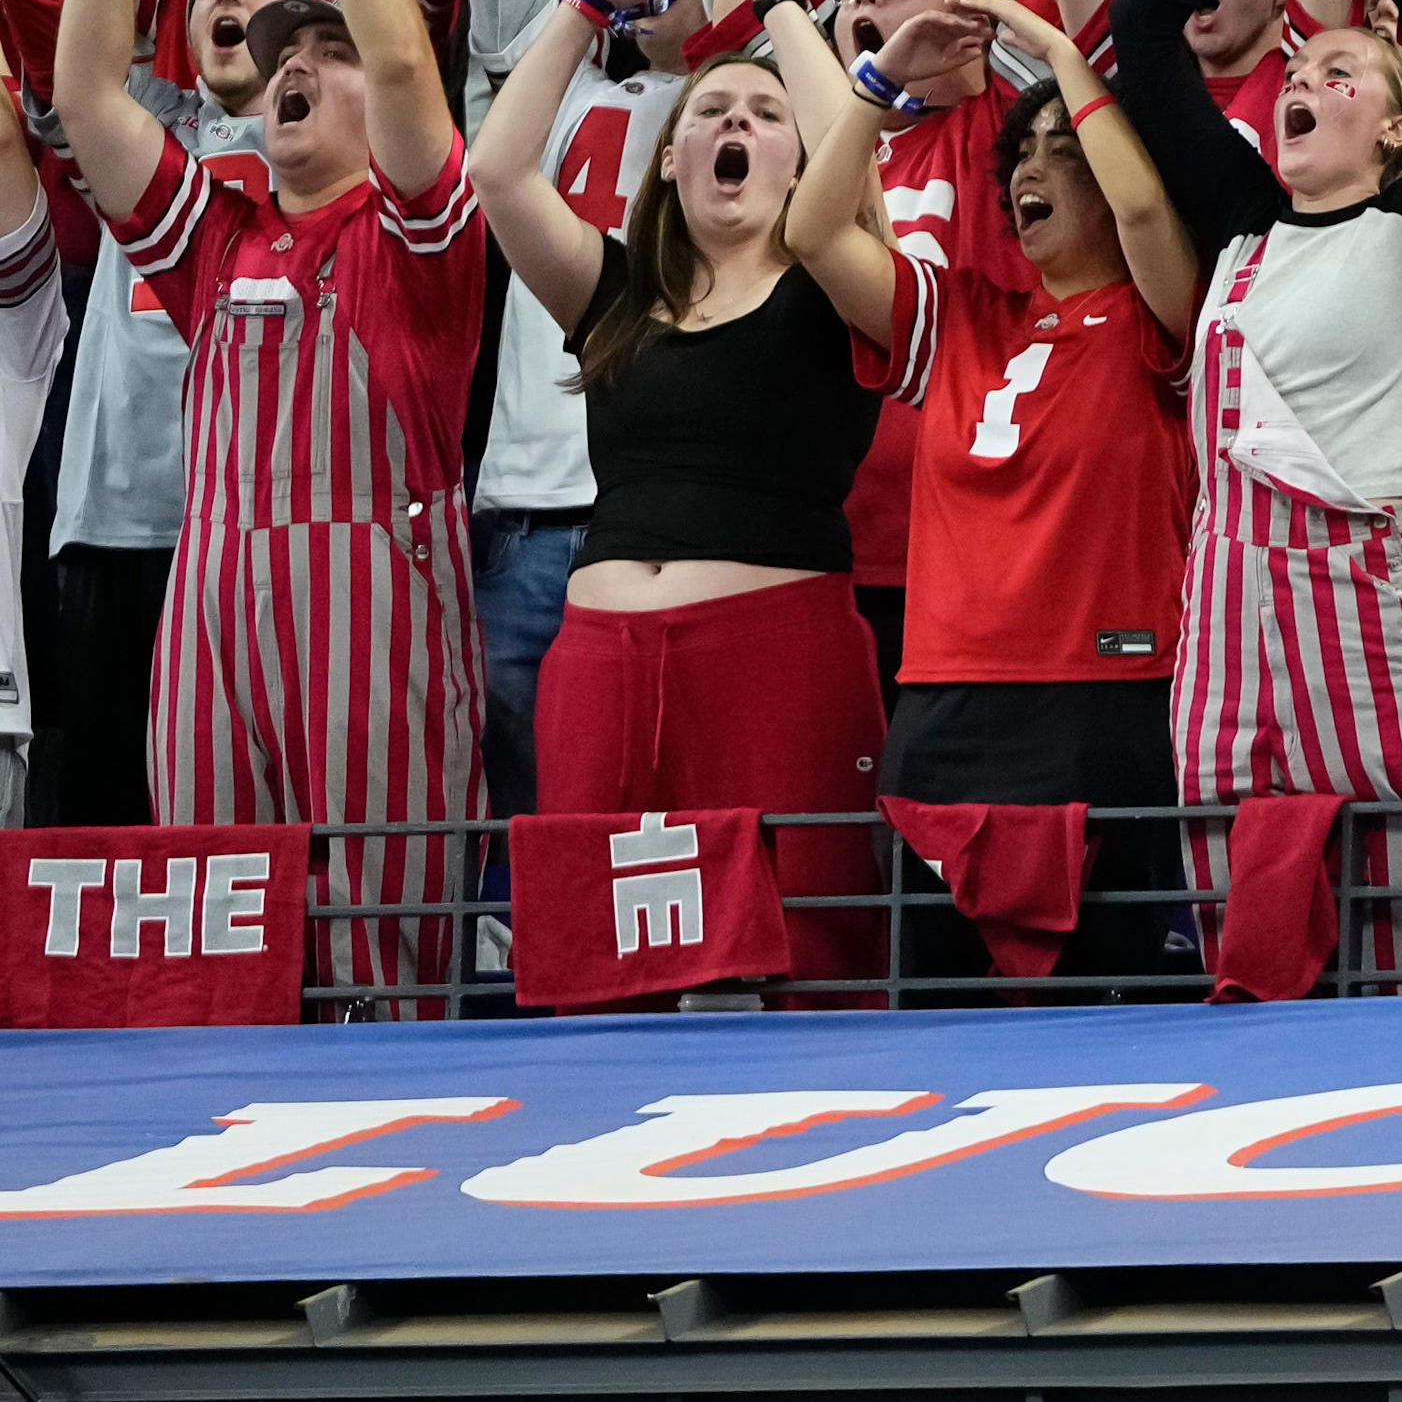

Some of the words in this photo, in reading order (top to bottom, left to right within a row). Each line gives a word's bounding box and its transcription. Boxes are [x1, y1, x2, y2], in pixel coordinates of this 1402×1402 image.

[559, 106, 631, 234] 4
[969, 342, 1054, 459] 1
[27, 851, 271, 958] THE
